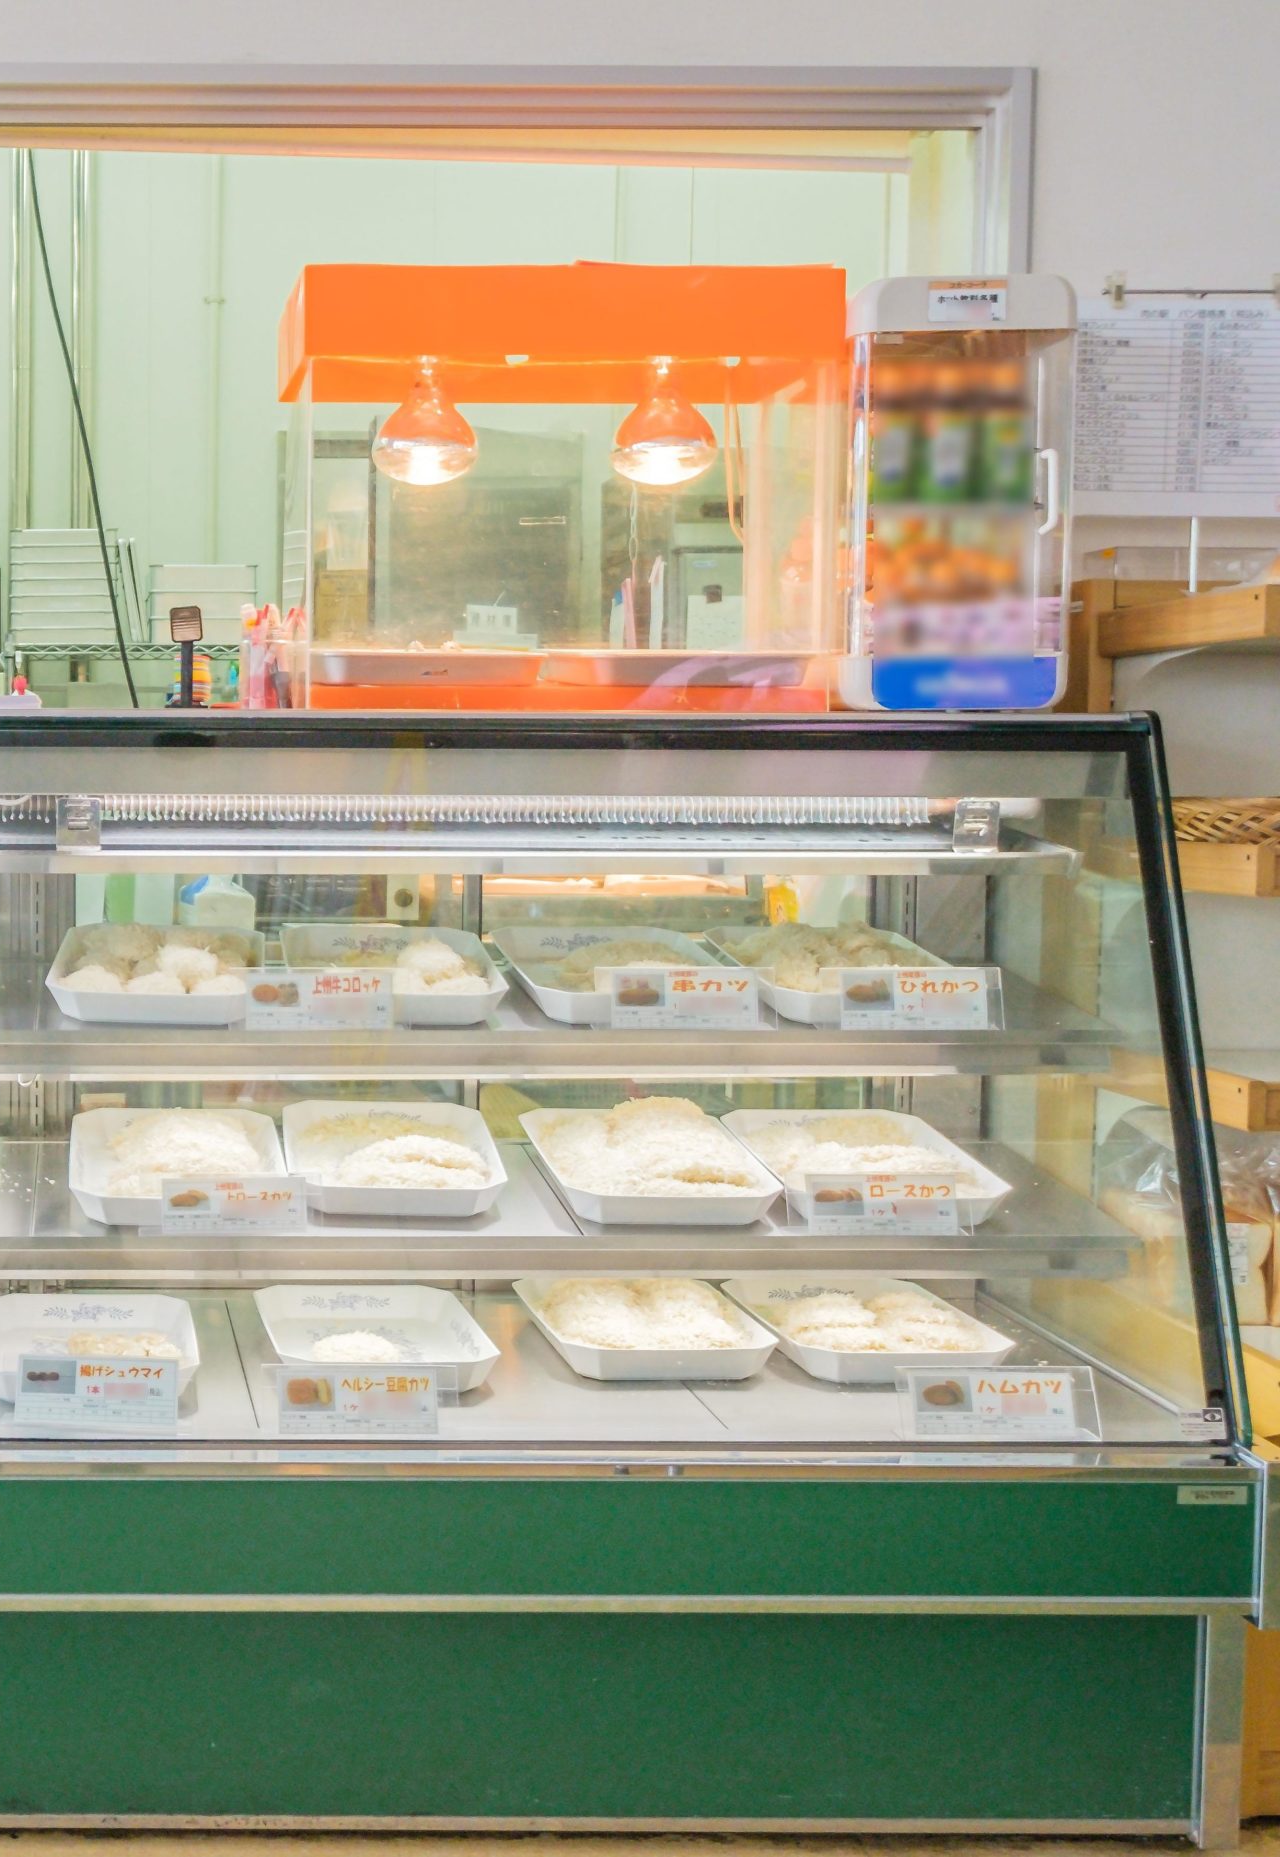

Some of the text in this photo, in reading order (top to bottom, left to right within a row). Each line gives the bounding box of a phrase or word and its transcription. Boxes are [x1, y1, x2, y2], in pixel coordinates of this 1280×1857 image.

[312, 975, 381, 994] 上州牛コロッケ
[672, 980, 750, 992] 串カツ
[900, 981, 980, 994] ひれかつ
[870, 1184, 951, 1198] ロースかつ
[80, 1364, 165, 1378] 揚げシュウマイ
[341, 1376, 430, 1392] ヘルシー豆腐カツ
[977, 1379, 1062, 1394] ハムカツ
